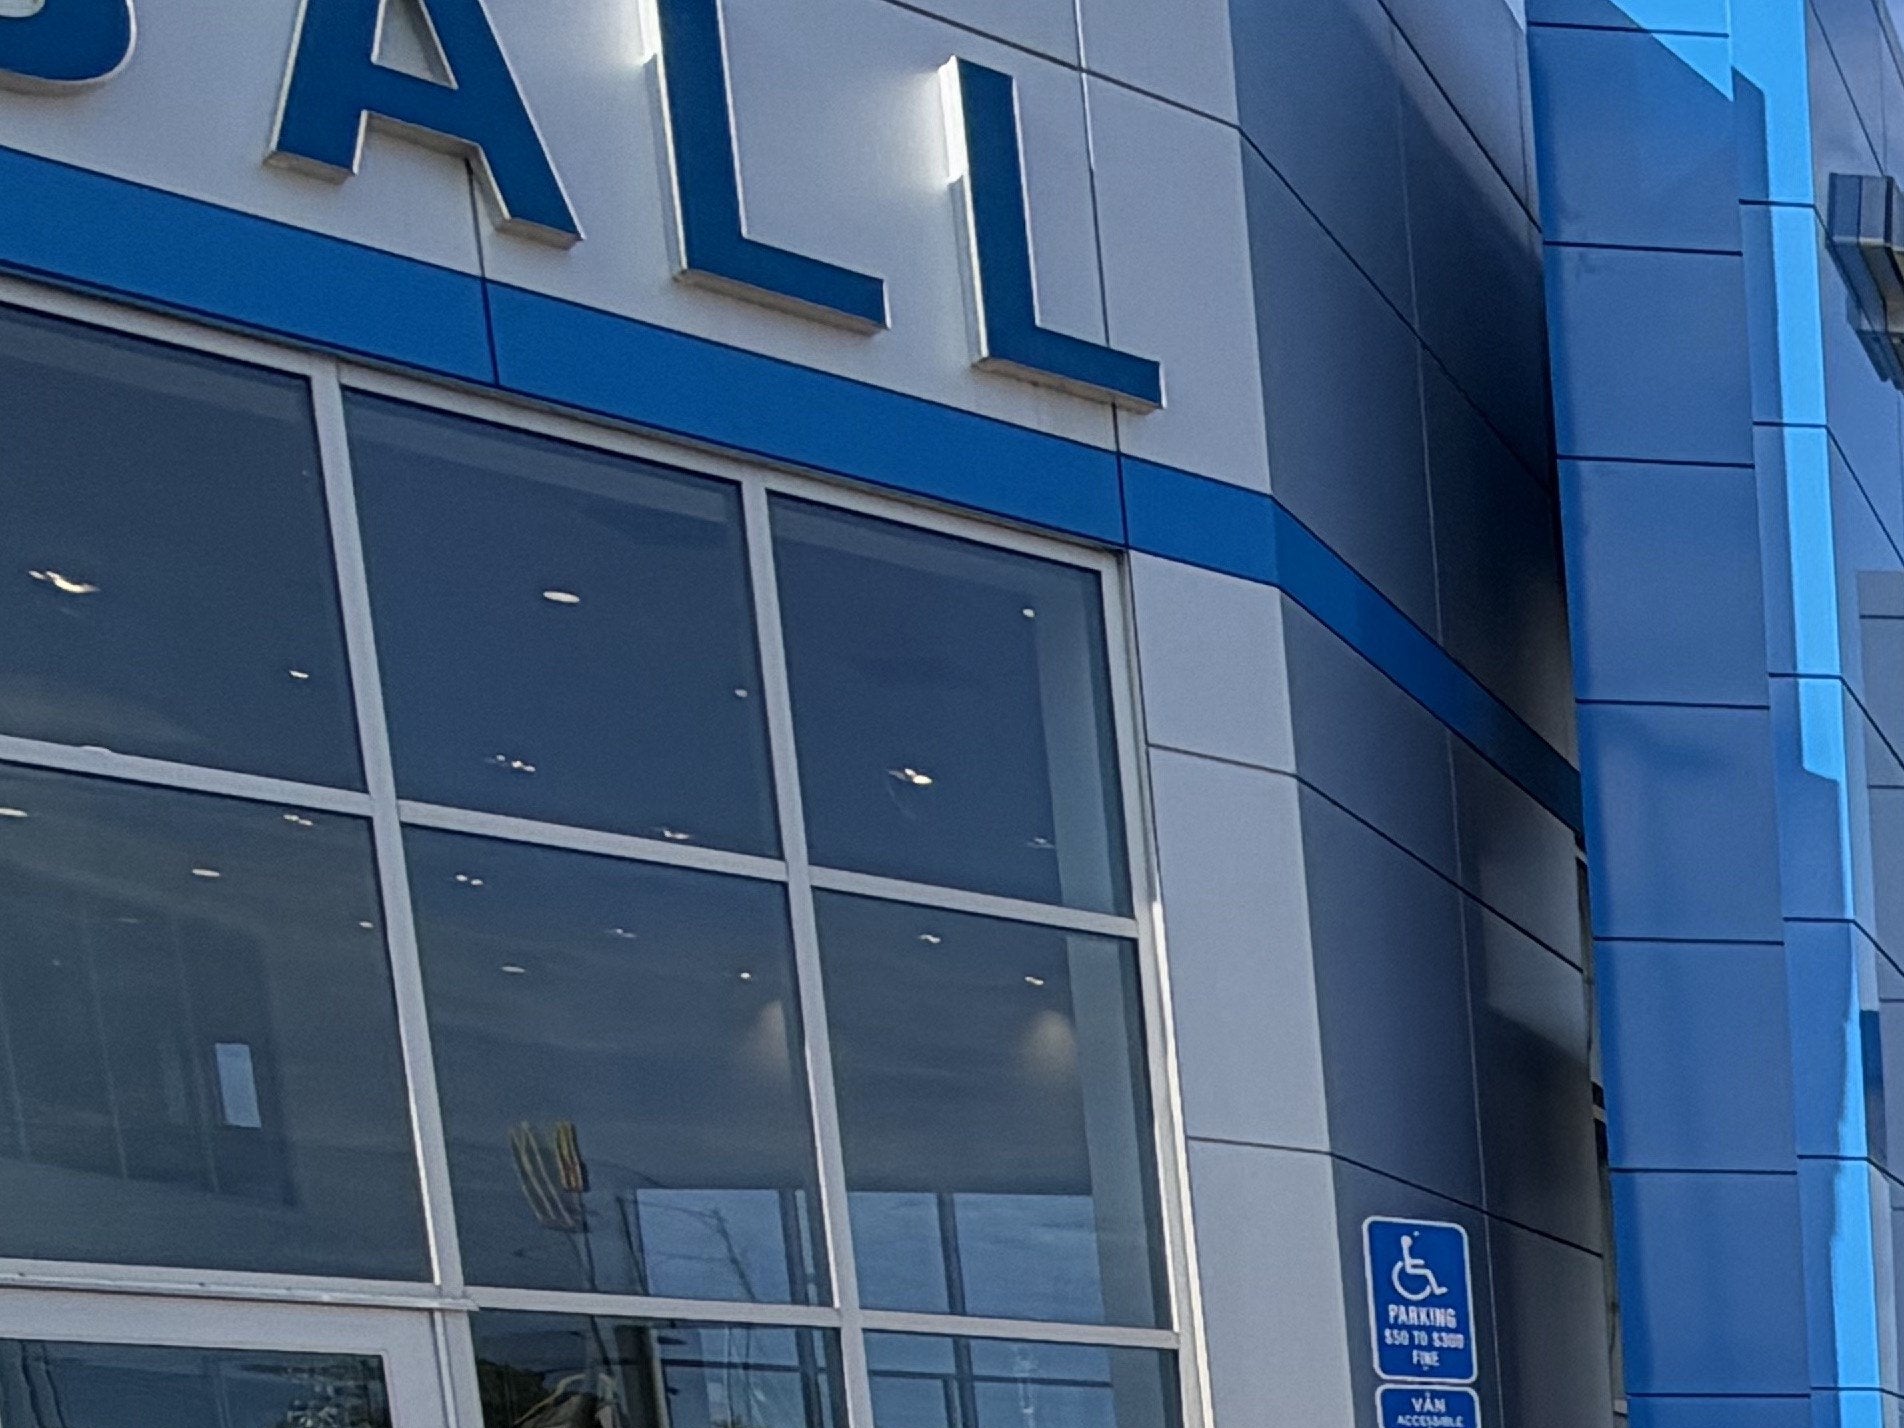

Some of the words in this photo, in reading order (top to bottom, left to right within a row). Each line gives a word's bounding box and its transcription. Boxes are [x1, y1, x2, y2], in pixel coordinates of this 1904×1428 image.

[0, 0, 1165, 410] ALL
[1388, 1304, 1457, 1329] PARKING
[1384, 1328, 1410, 1346] $50
[1412, 1330, 1429, 1346] TO
[1412, 1351, 1440, 1367] FINE
[1411, 1396, 1446, 1414] VAN
[1396, 1415, 1465, 1428] ACCESSIBLE
